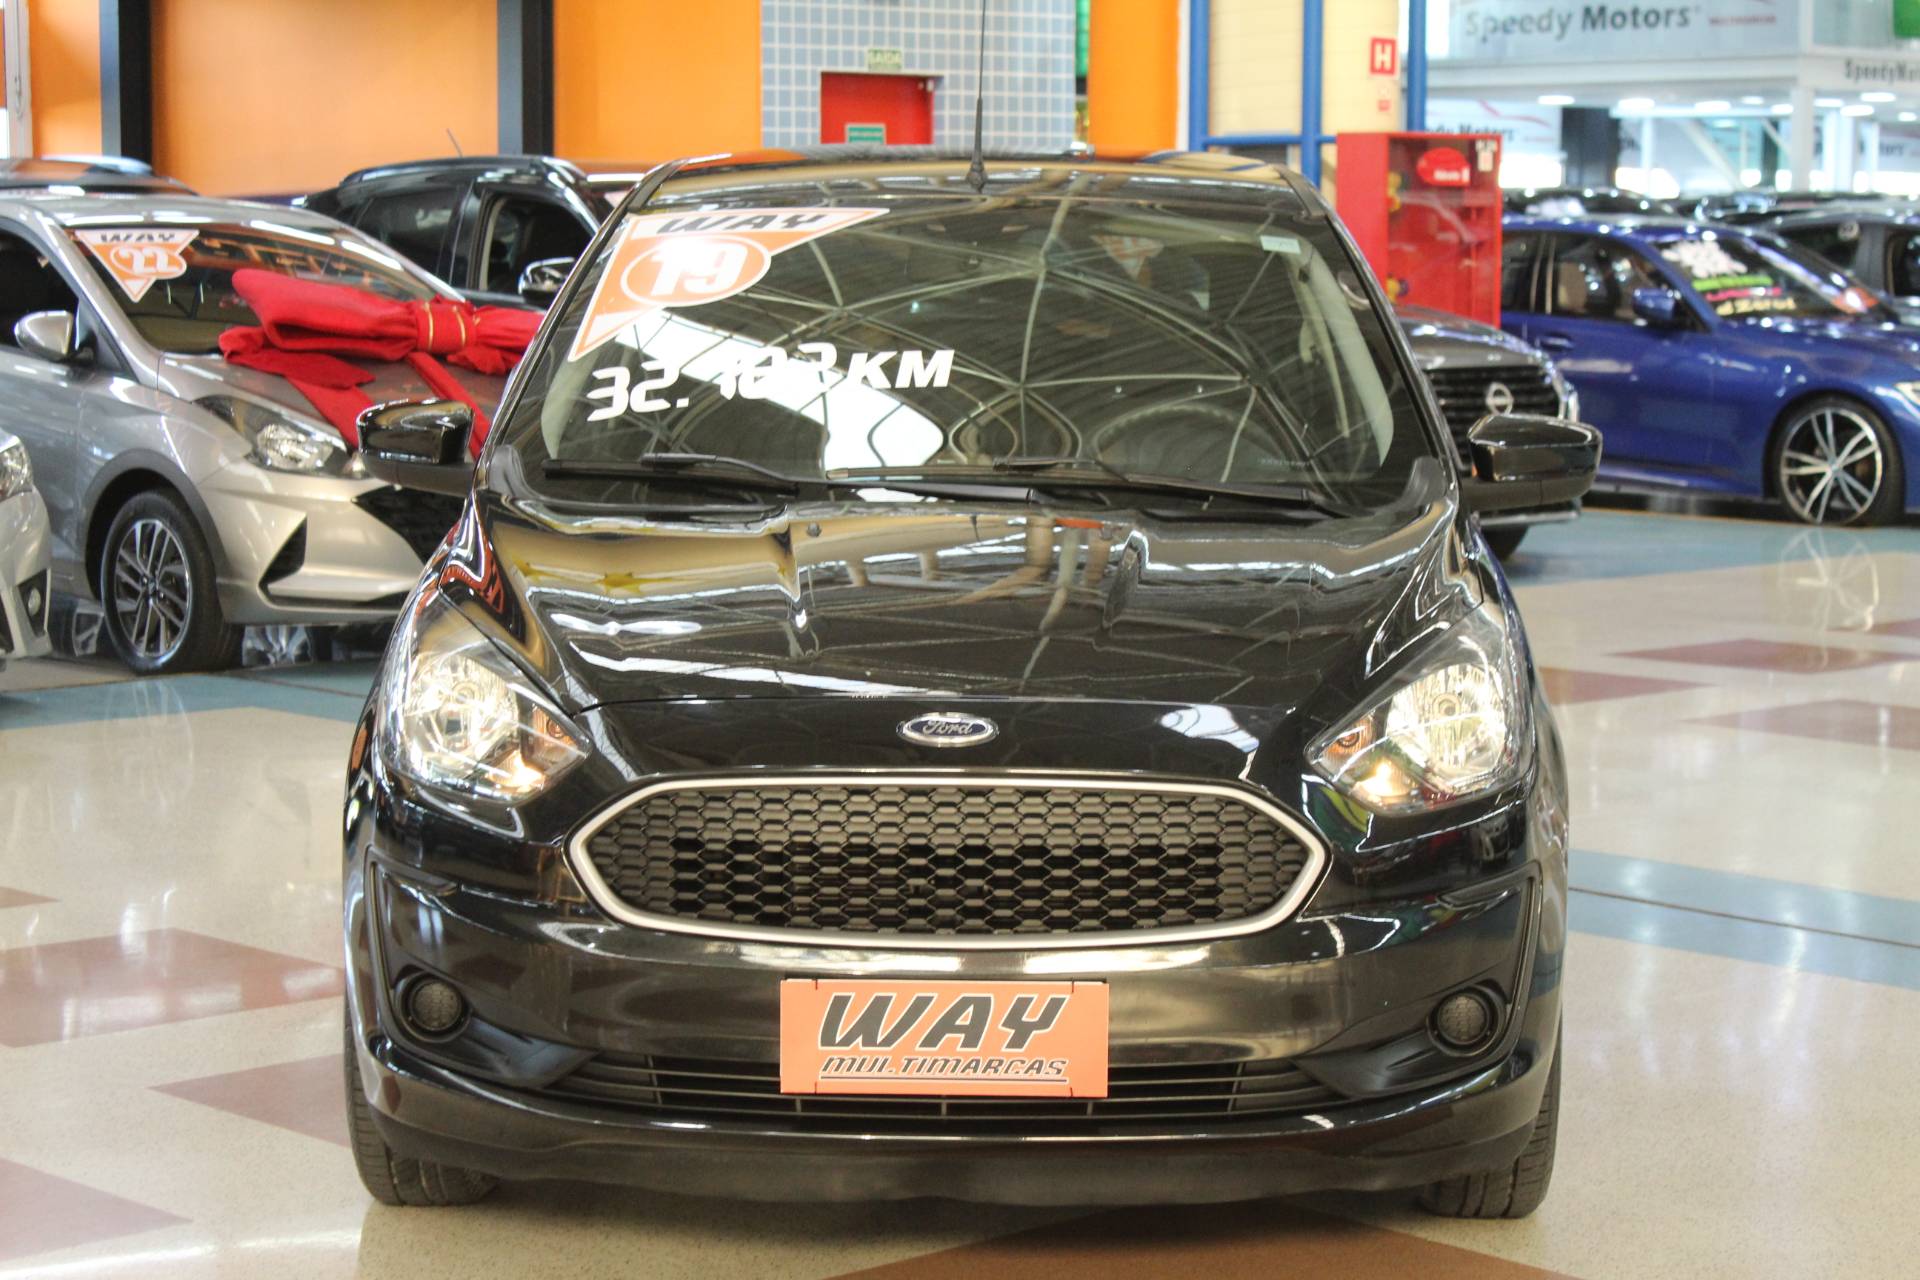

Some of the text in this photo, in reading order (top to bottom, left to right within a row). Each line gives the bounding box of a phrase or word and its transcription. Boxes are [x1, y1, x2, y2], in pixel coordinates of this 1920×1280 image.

[1464, 6, 1573, 43] Speedy
[1581, 5, 1692, 31] Motors
[1374, 42, 1393, 71] H
[100, 233, 176, 242] WAY
[656, 214, 832, 234] WAY
[118, 247, 181, 275] 22
[649, 240, 750, 297] 19
[843, 349, 955, 388] KM
[922, 719, 973, 735] Ford
[819, 992, 1071, 1053] WAY
